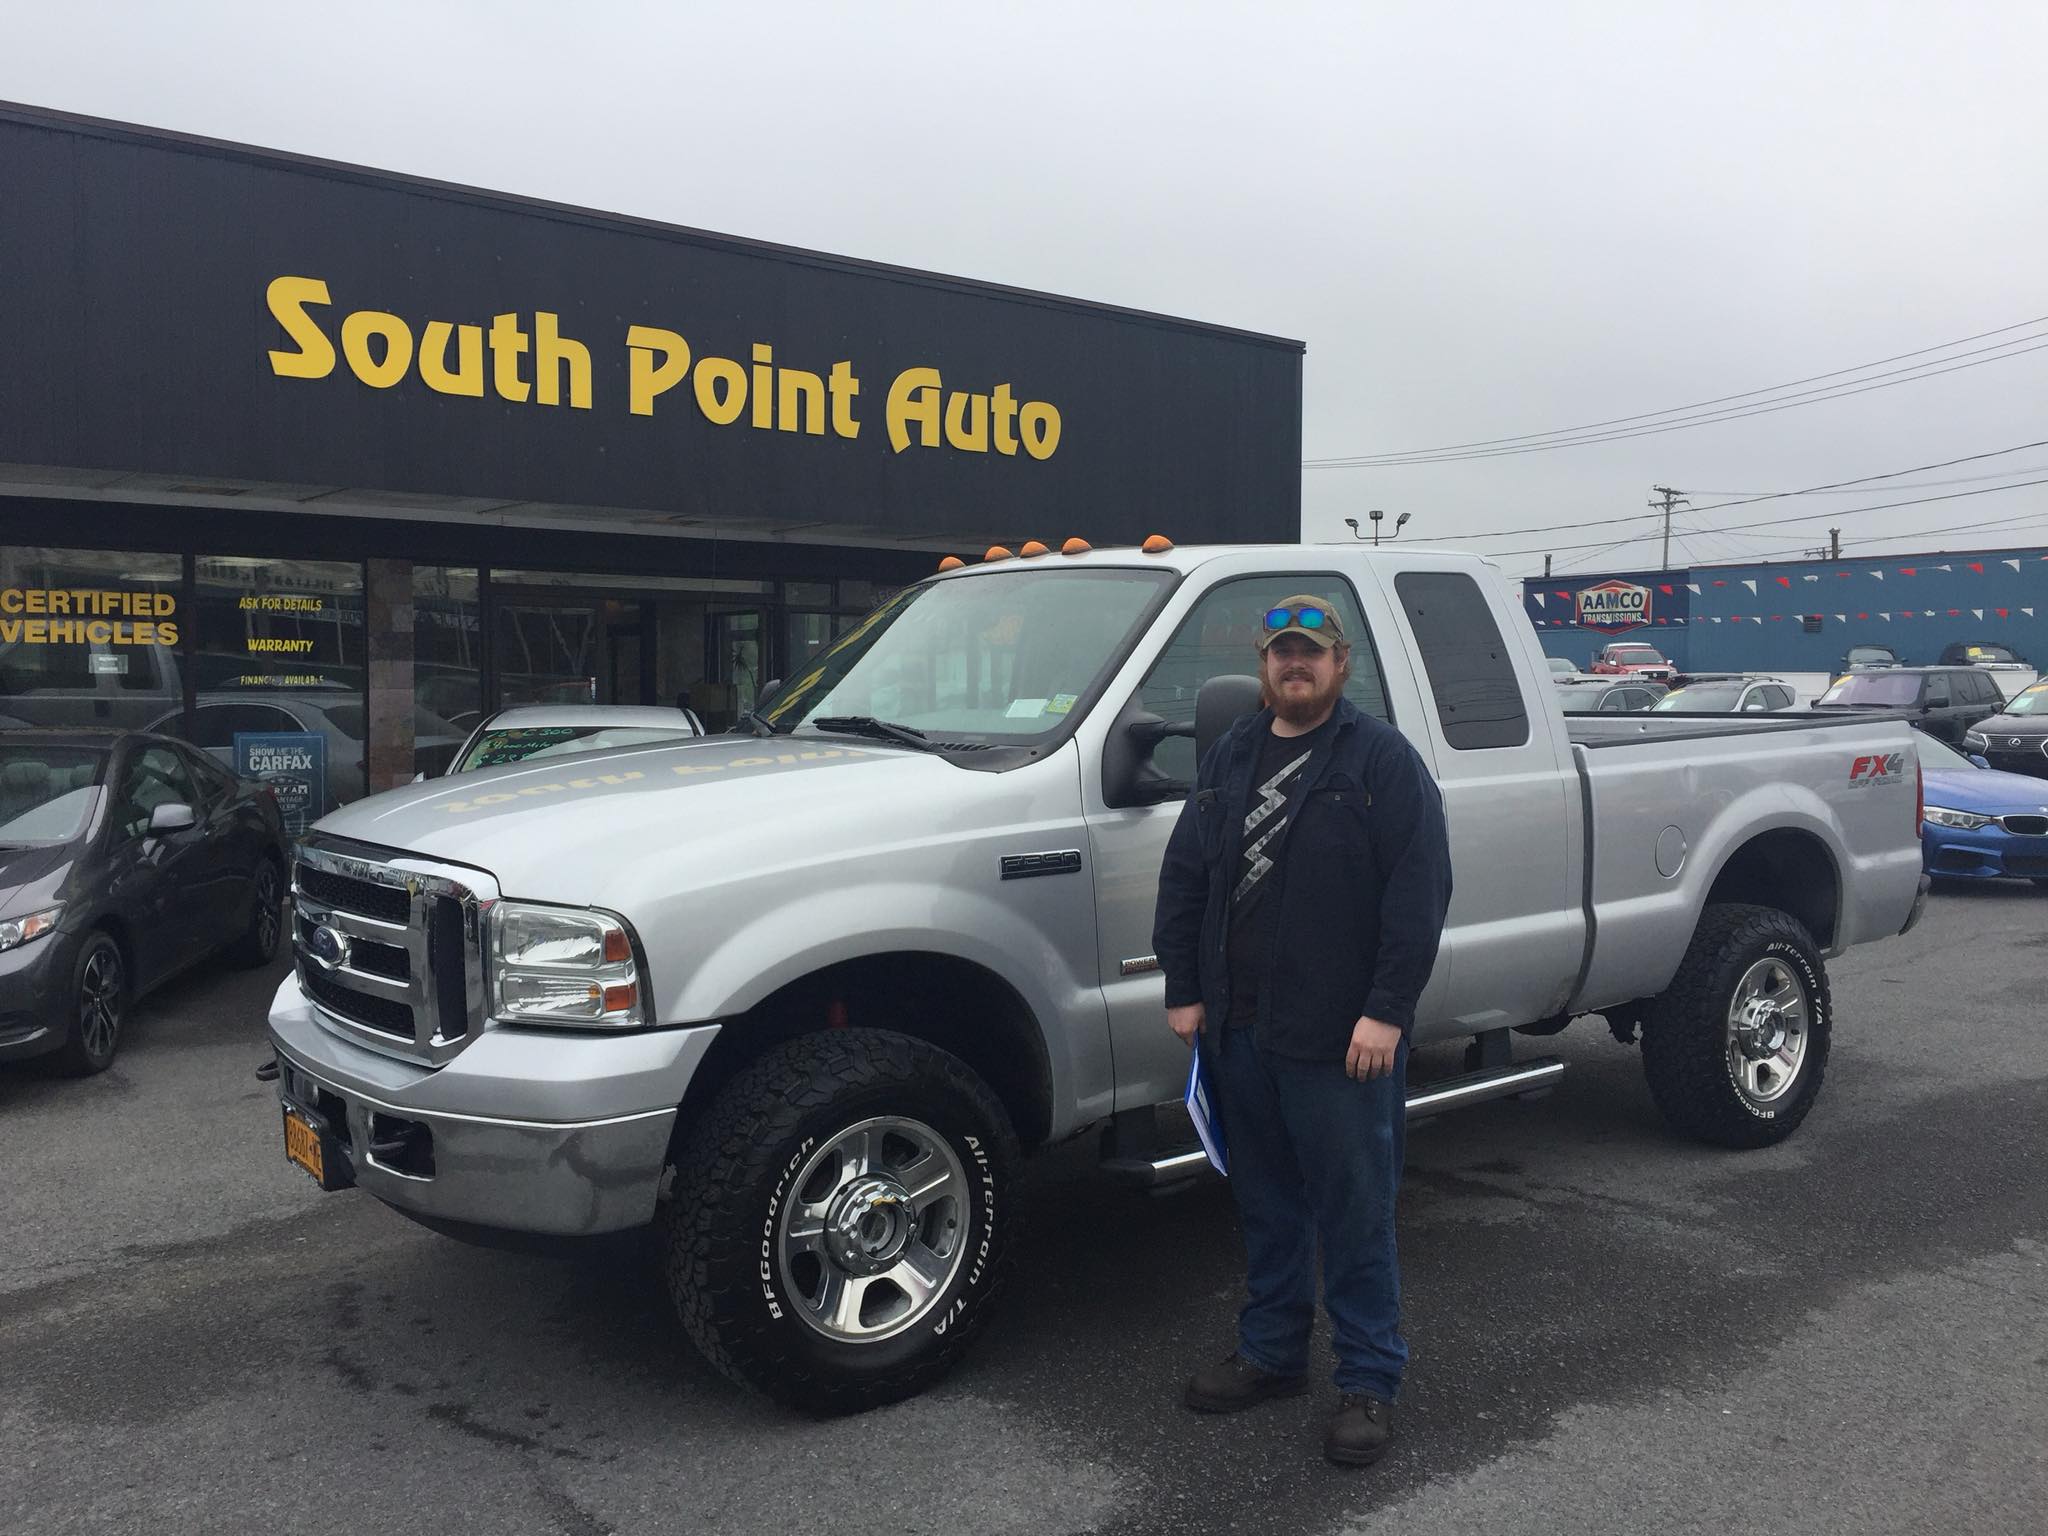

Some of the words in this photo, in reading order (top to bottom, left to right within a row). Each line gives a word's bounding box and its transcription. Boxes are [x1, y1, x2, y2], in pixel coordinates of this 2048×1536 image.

[266, 276, 592, 409] South
[625, 325, 861, 439] Point
[886, 367, 1062, 461] Auto
[0, 588, 176, 617] CERTIFIED
[239, 597, 259, 609] ASK
[262, 598, 281, 610] FOR
[283, 598, 322, 611] DETAILS
[1583, 592, 1643, 610] AAMCO
[1583, 612, 1642, 623] TRANSMISSIONS
[0, 619, 179, 646] VEHICLES
[247, 638, 314, 652] WARRANTY
[240, 675, 282, 686] FINANCI
[249, 747, 275, 756] SHOW
[249, 755, 312, 771] CARFAX
[1850, 753, 1904, 779] FX4
[1766, 942, 1817, 988] All-Terrain
[1815, 996, 1823, 1025] T/A
[963, 1135, 995, 1286] All-Terrain
[759, 1136, 815, 1320] BFGoodrich
[933, 1297, 968, 1336] T/A
